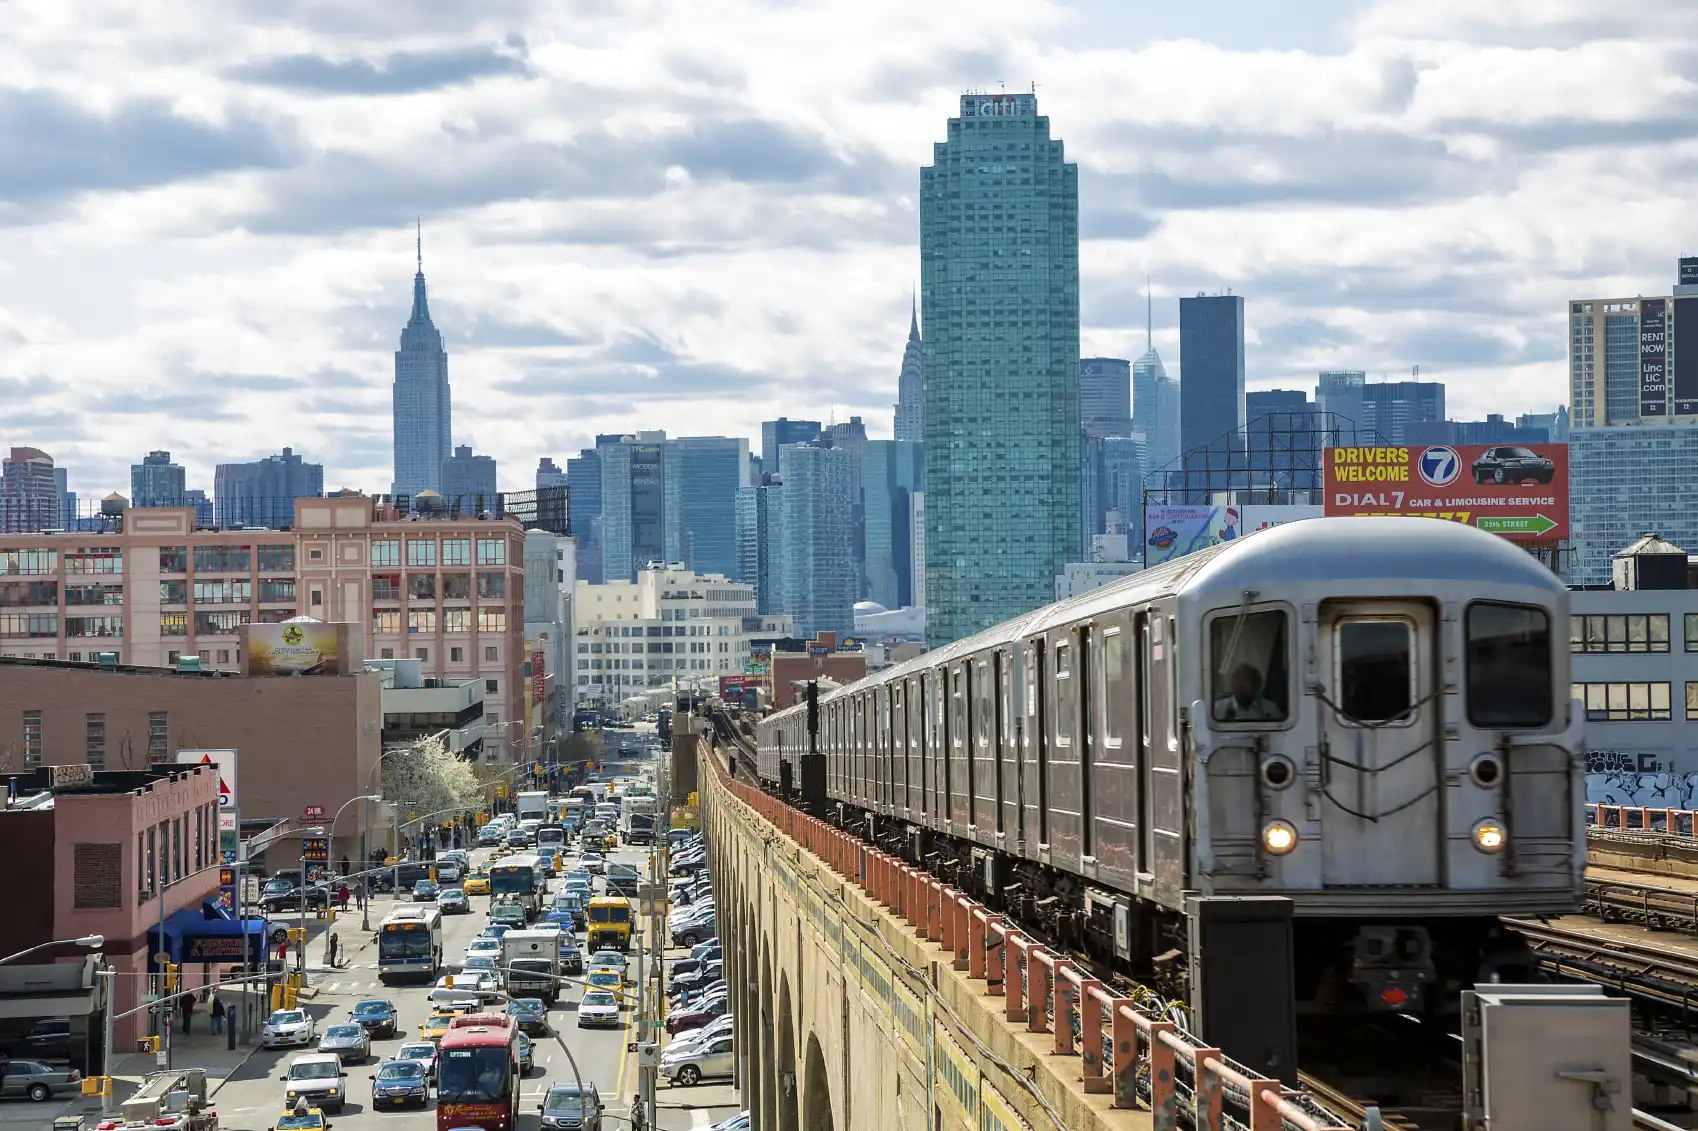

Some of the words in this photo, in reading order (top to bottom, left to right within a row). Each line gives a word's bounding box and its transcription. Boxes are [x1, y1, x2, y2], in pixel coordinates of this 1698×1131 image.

[980, 97, 1015, 116] citi
[1641, 333, 1664, 342] RENT
[1641, 344, 1665, 353] NOW
[1643, 364, 1663, 372] Linc
[1645, 374, 1661, 382] LIC
[1334, 447, 1409, 464] DRIVERS
[1425, 450, 1453, 484] 7
[1334, 466, 1409, 482] WELCOME
[1409, 498, 1432, 507] CAR
[1434, 498, 1442, 507] &
[1445, 497, 1506, 507] LIMOUSINE
[1507, 497, 1555, 506] SERVICE
[1483, 520, 1500, 528] 35th
[307, 807, 313, 815] 24
[305, 851, 327, 860] WASH
